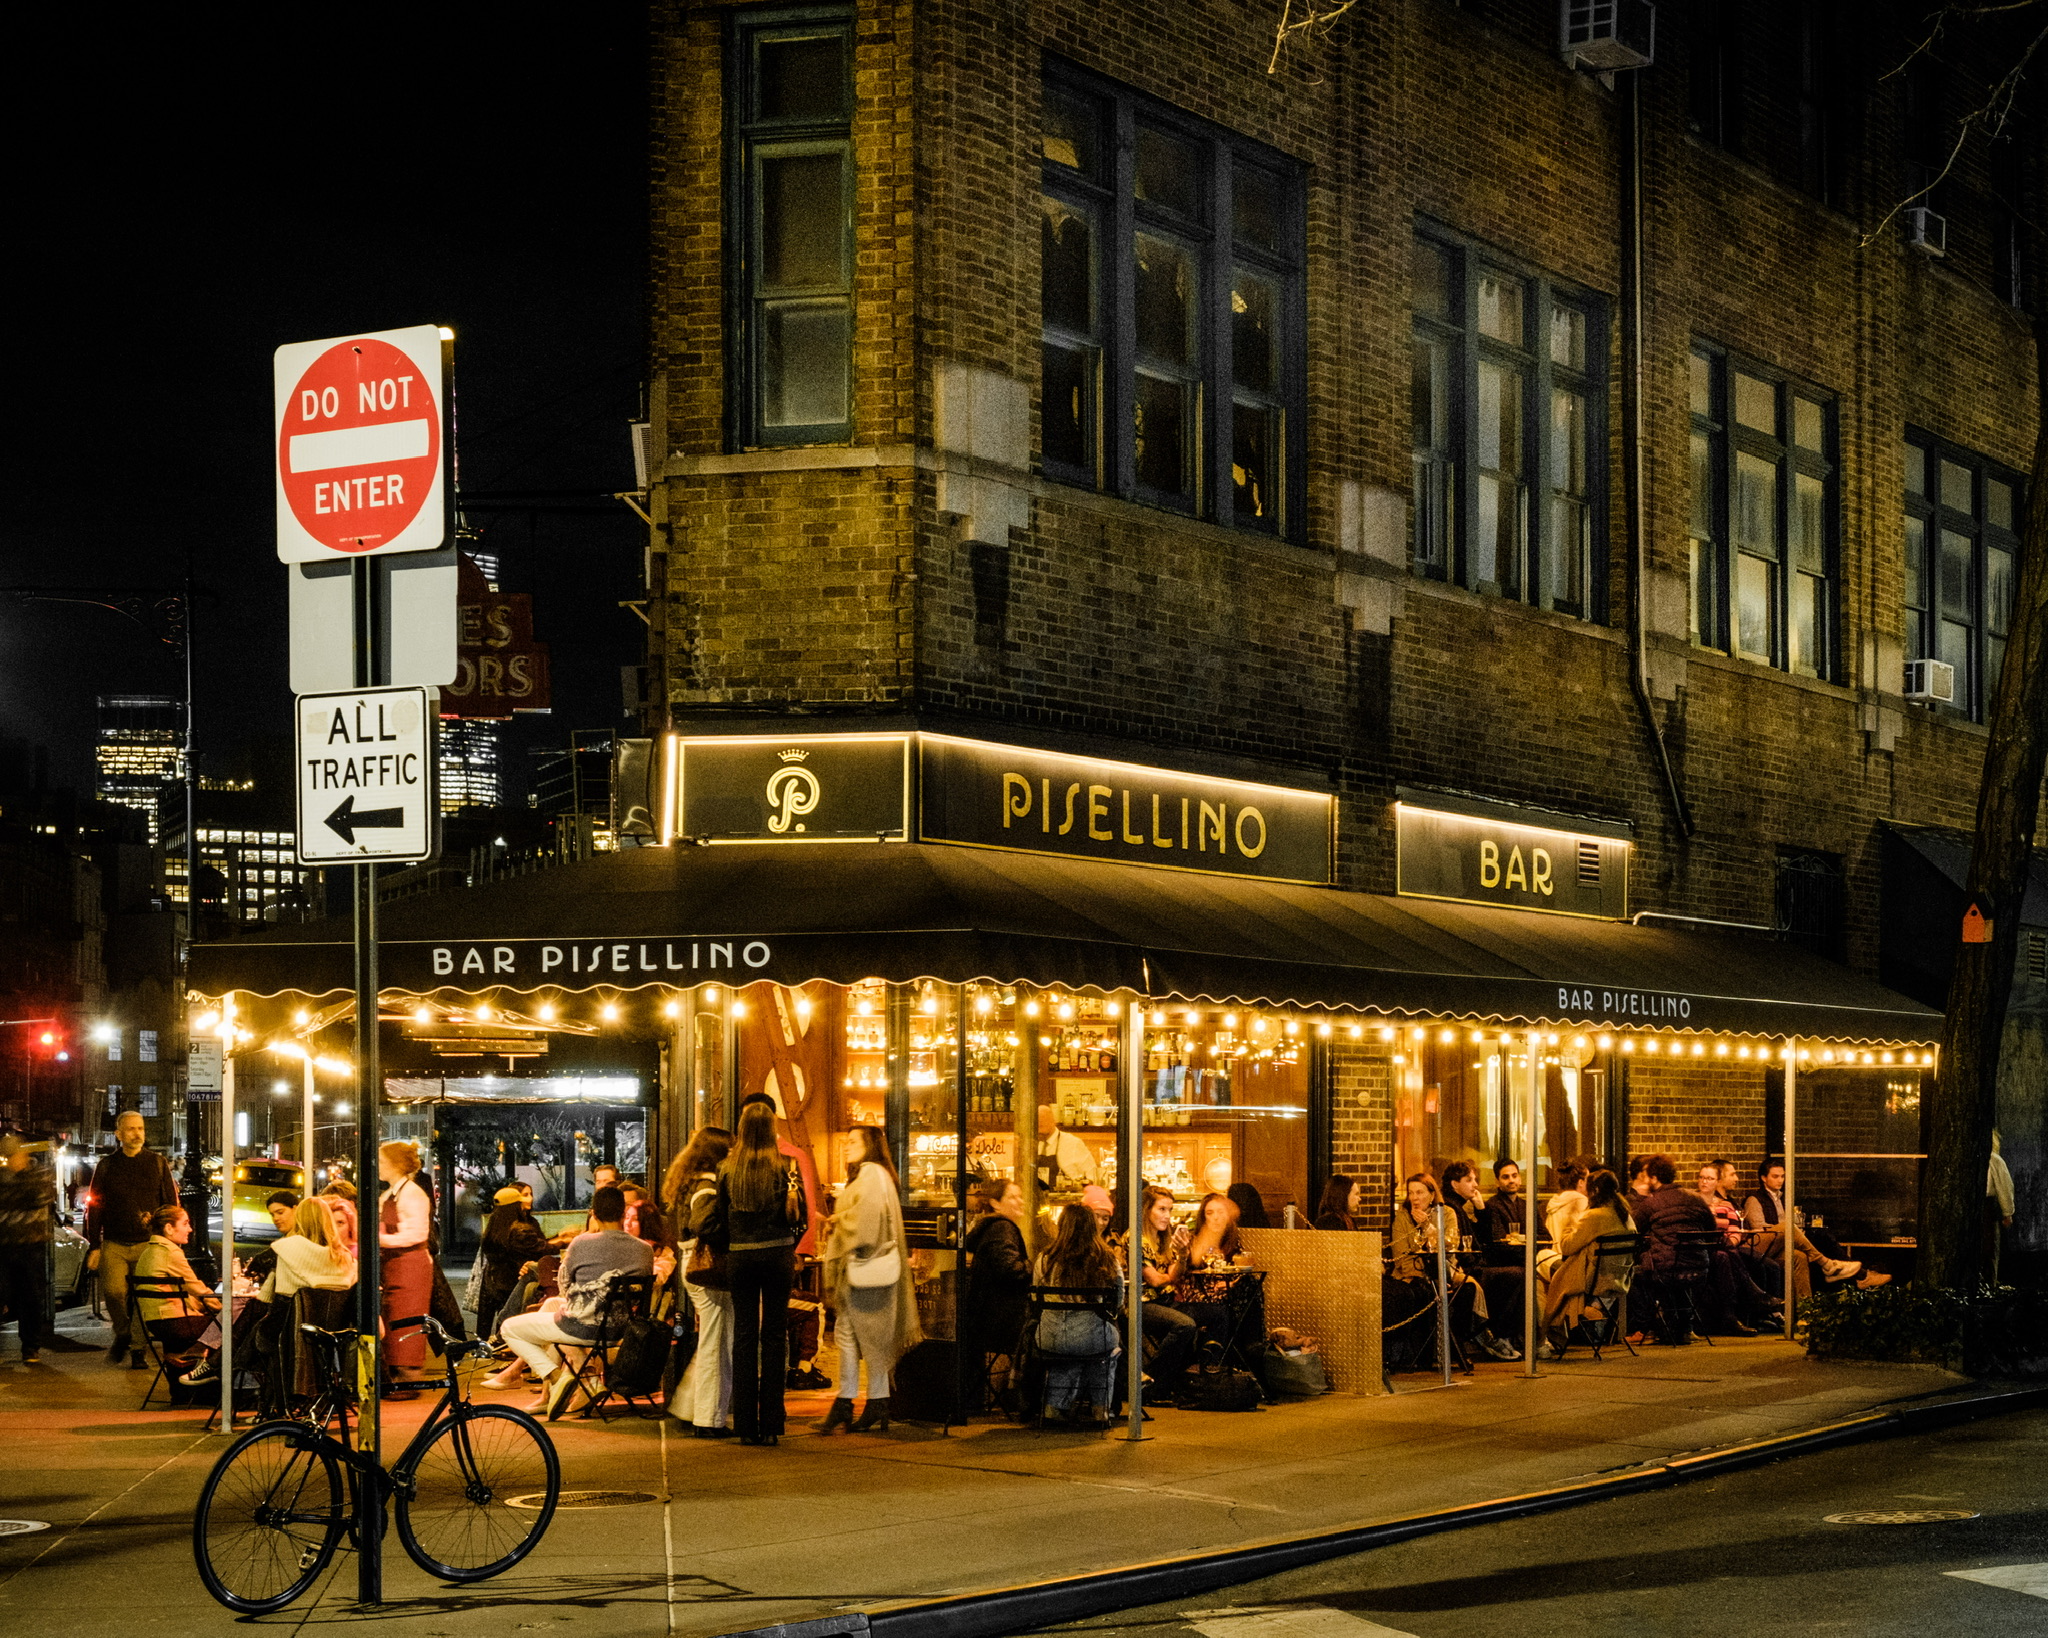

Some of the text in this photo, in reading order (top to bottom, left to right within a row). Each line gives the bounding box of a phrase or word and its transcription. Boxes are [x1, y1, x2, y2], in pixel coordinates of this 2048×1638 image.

[301, 376, 414, 421] DO NOT
[315, 474, 404, 515] ENTER
[457, 605, 513, 648] ES
[446, 655, 533, 698] ORS
[328, 704, 397, 745] ALL
[307, 752, 418, 790] TRAFFIC
[1002, 772, 1267, 859] PISELLINO
[1480, 840, 1554, 896] BAR
[432, 941, 771, 975] BAR PISELLINO
[1558, 988, 1691, 1018] BAR PISELLINO
[191, 1044, 197, 1053] 2
[975, 1137, 1006, 1154] Dolci
